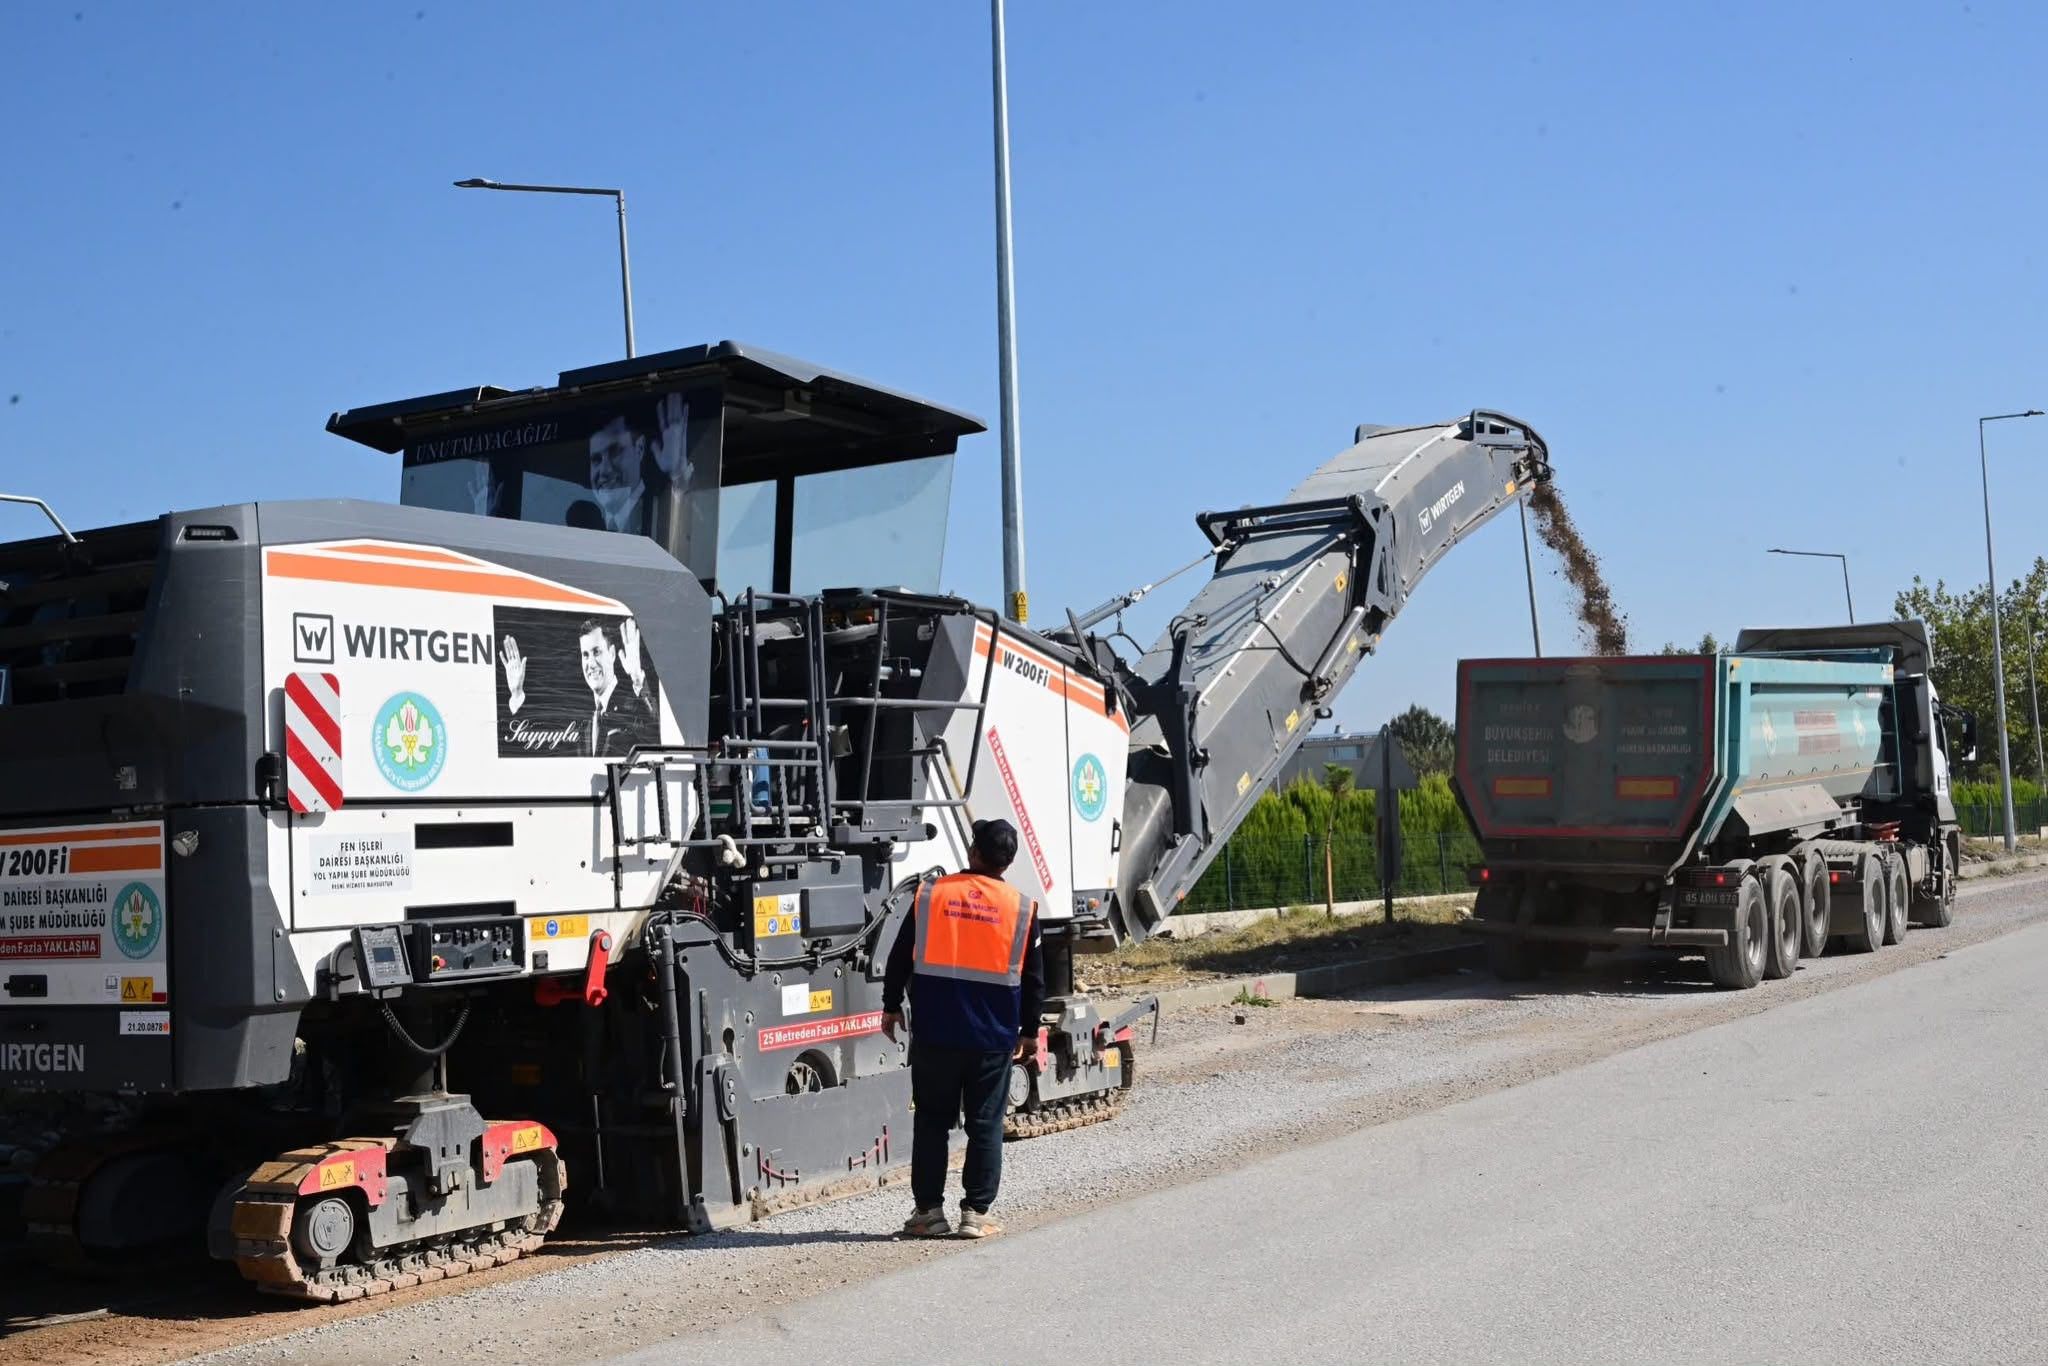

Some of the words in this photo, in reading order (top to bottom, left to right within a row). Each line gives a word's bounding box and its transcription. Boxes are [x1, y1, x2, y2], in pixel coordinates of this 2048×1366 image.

[416, 422, 559, 463] UNUTMAYACAĞIZ!
[1430, 480, 1465, 520] WIRTGEN
[343, 623, 492, 665] WIRTGEN
[1003, 650, 1015, 670] W
[1015, 657, 1049, 687] 200Fi
[504, 719, 579, 750] Saygıyla
[340, 842, 355, 852] FEN
[358, 838, 383, 854] İŞLERİ
[8, 846, 68, 876] 200Fi
[319, 854, 352, 867] DAİRESİ
[354, 852, 404, 868] BAŞKANLIĞI
[313, 872, 327, 881] YOL
[329, 871, 349, 880] YAPIM
[4, 886, 42, 906] DAİRESİ
[46, 883, 107, 908] BAŞKANLIĞI
[9, 915, 35, 934] ŞUBE
[39, 909, 106, 929] MÜDÜRLÜĞÜ
[17, 941, 42, 953] Fazla
[43, 939, 97, 955] YAKLAŞMA
[763, 1033, 774, 1045] 25
[775, 1028, 816, 1043] Metreden
[816, 1023, 839, 1036] Fazla
[0, 1043, 85, 1072] IRTGEN
